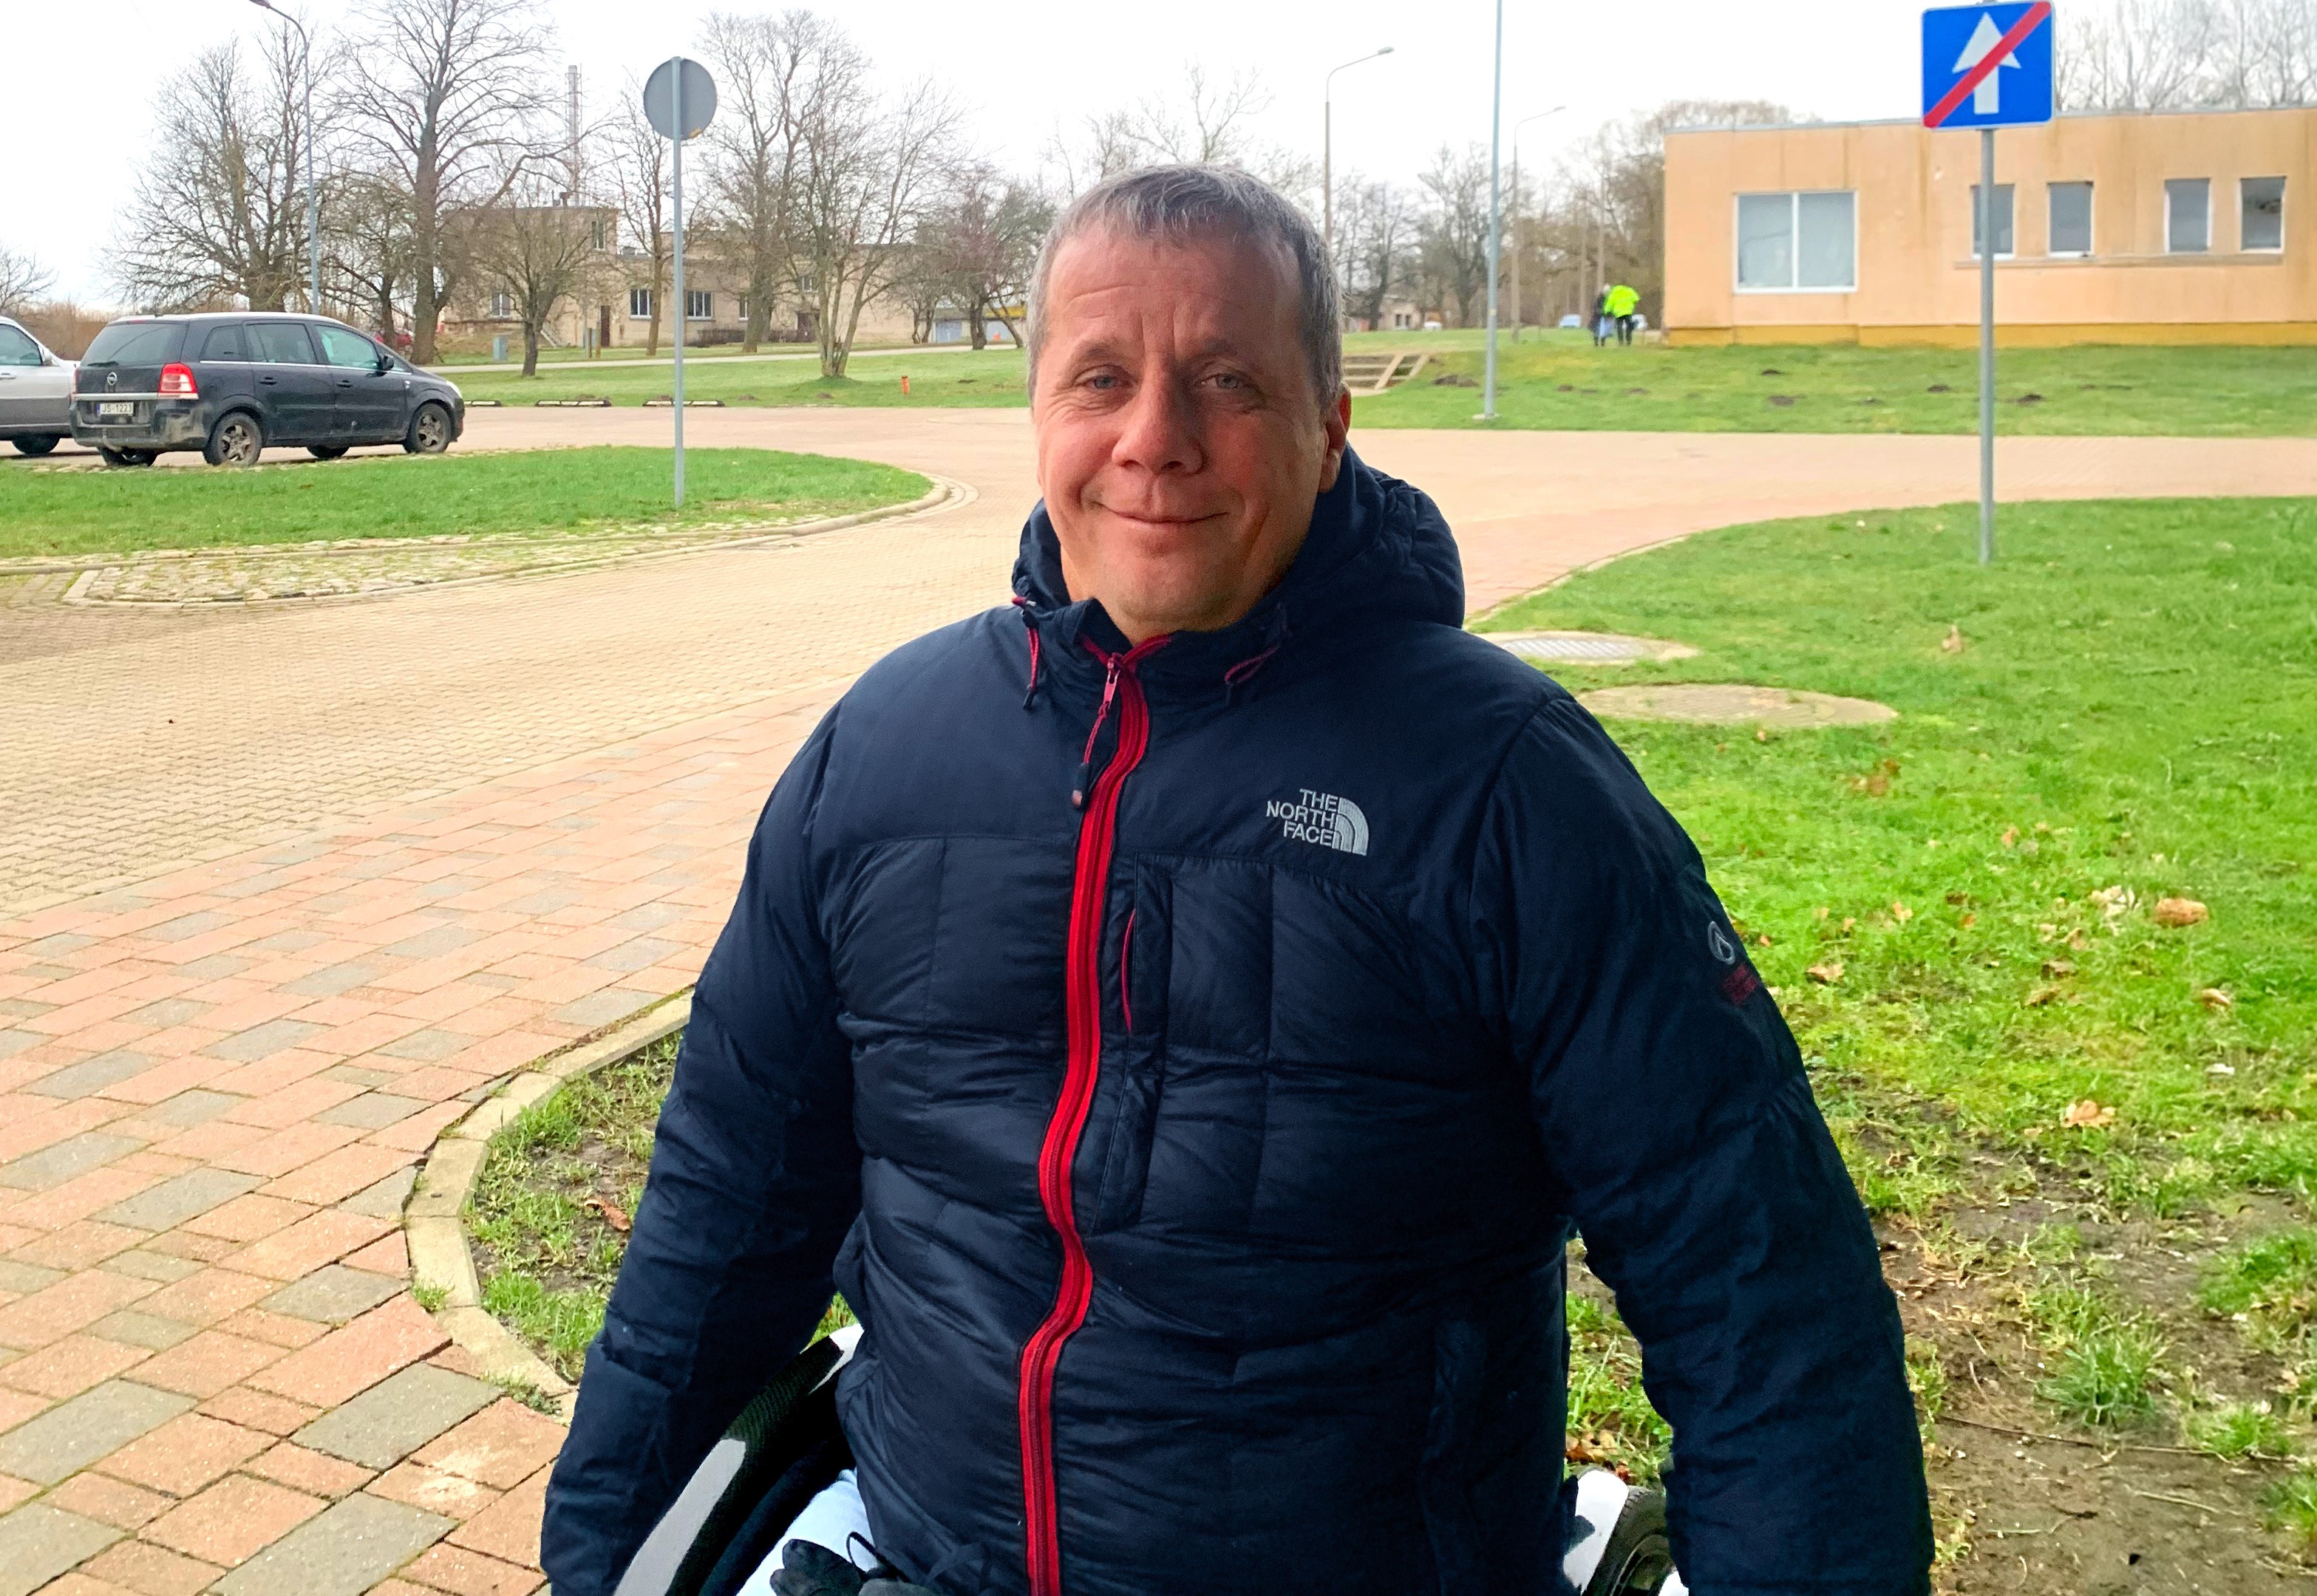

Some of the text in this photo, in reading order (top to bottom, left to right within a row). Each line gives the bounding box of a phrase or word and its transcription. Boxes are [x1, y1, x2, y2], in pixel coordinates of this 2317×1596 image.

[1299, 788, 1338, 812] THE
[1266, 799, 1336, 829] NORTH
[1283, 820, 1334, 847] FACE
